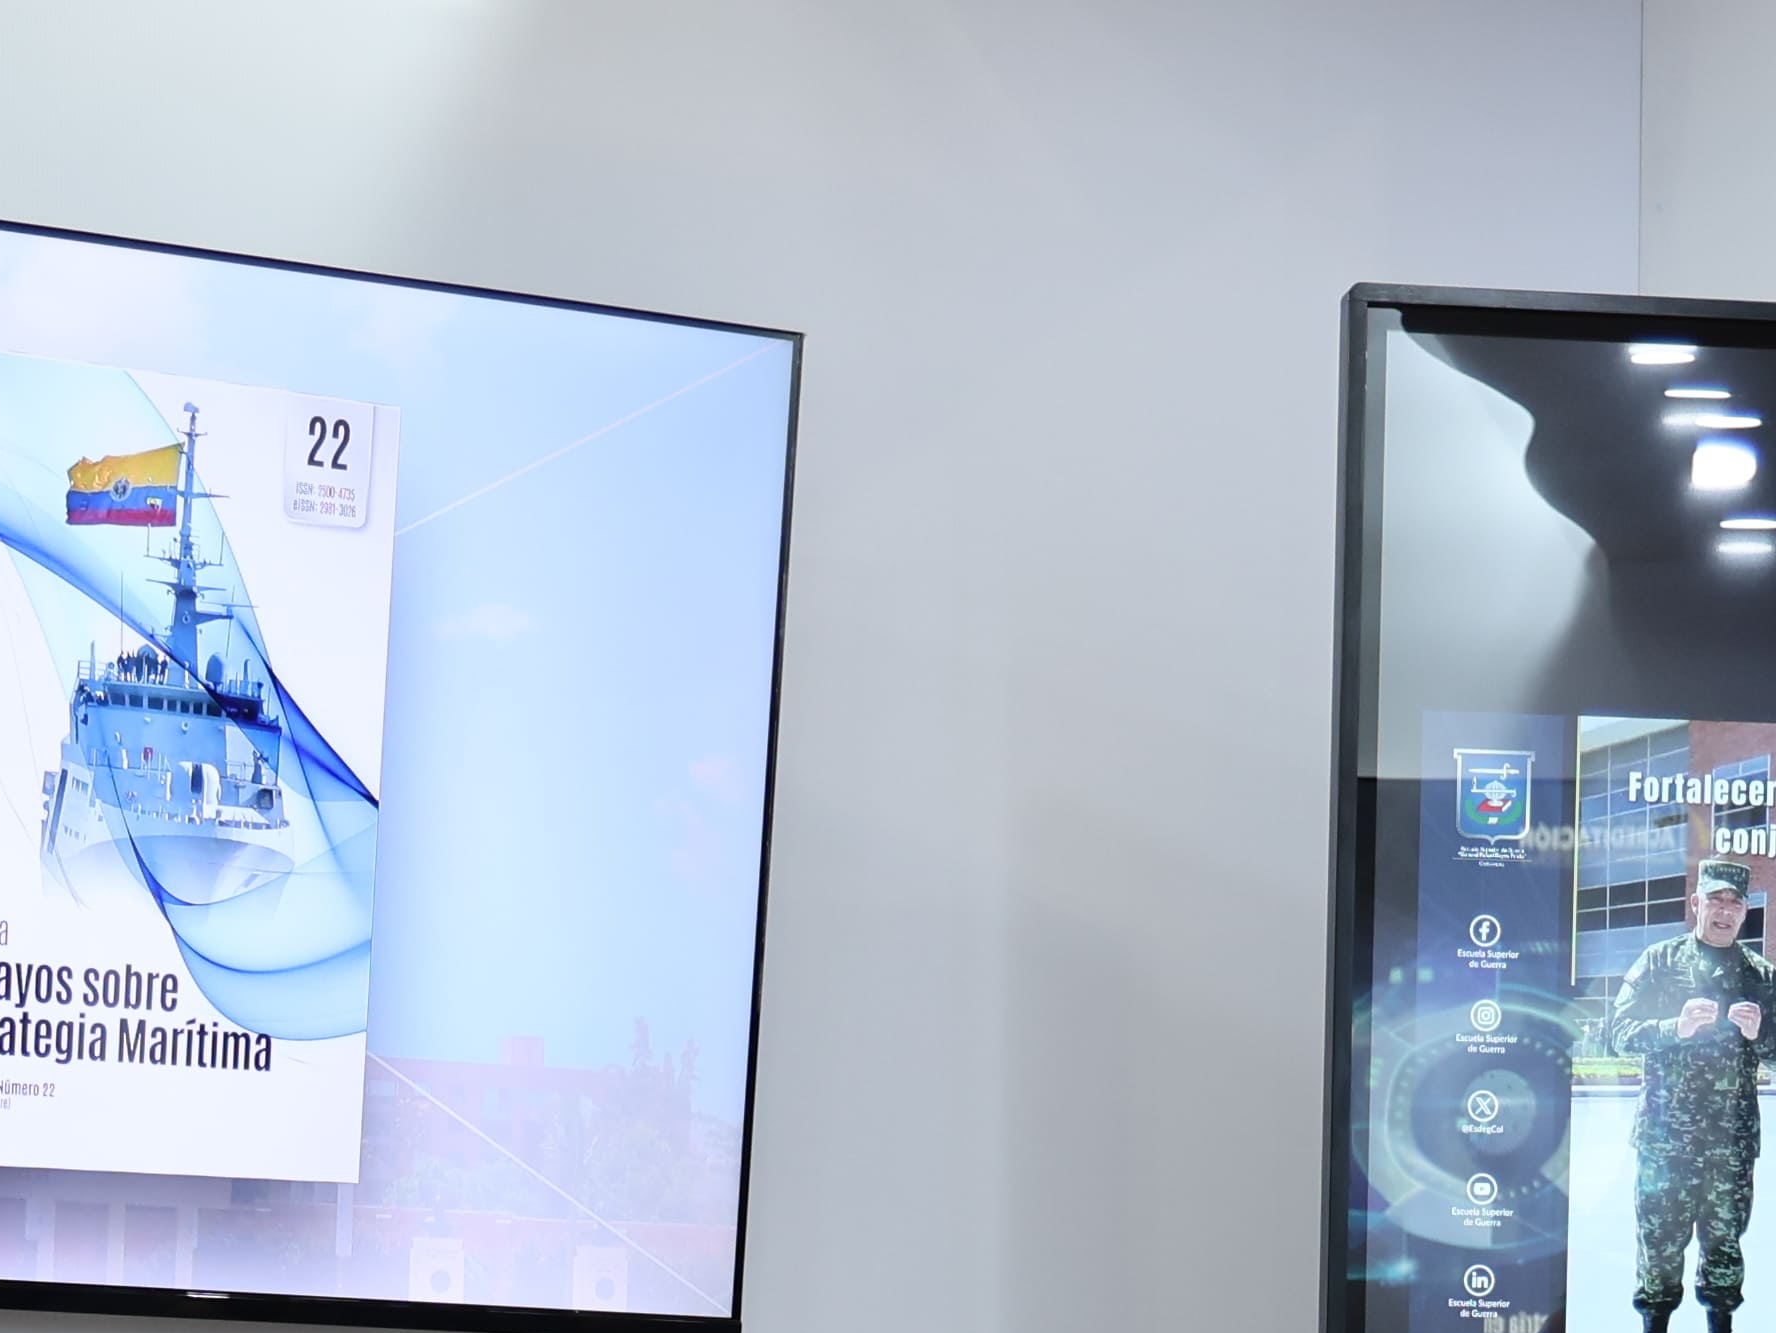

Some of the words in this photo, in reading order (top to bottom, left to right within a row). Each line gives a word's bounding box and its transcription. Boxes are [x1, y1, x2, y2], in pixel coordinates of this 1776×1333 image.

[307, 415, 350, 470] 22
[1457, 949, 1485, 958] Escuela
[1487, 950, 1519, 960] Superior
[1469, 960, 1479, 968] de
[1480, 960, 1506, 969] Guerra
[82, 964, 180, 1012] sobre
[1456, 1033, 1484, 1042] Escuela
[1486, 1034, 1518, 1044] Superior
[118, 1017, 273, 1072] Marítima
[1467, 1044, 1477, 1052] de
[1479, 1044, 1505, 1053] Guerra
[42, 1082, 56, 1098] 22
[1451, 1207, 1480, 1216] Escuela
[1481, 1208, 1513, 1218] Superior
[1463, 1217, 1473, 1225] de
[1475, 1217, 1501, 1226] Guerra
[1448, 1299, 1476, 1308] Escuela
[1478, 1300, 1510, 1310] Superior
[1460, 1309, 1470, 1317] de
[1471, 1309, 1498, 1318] Guerra
